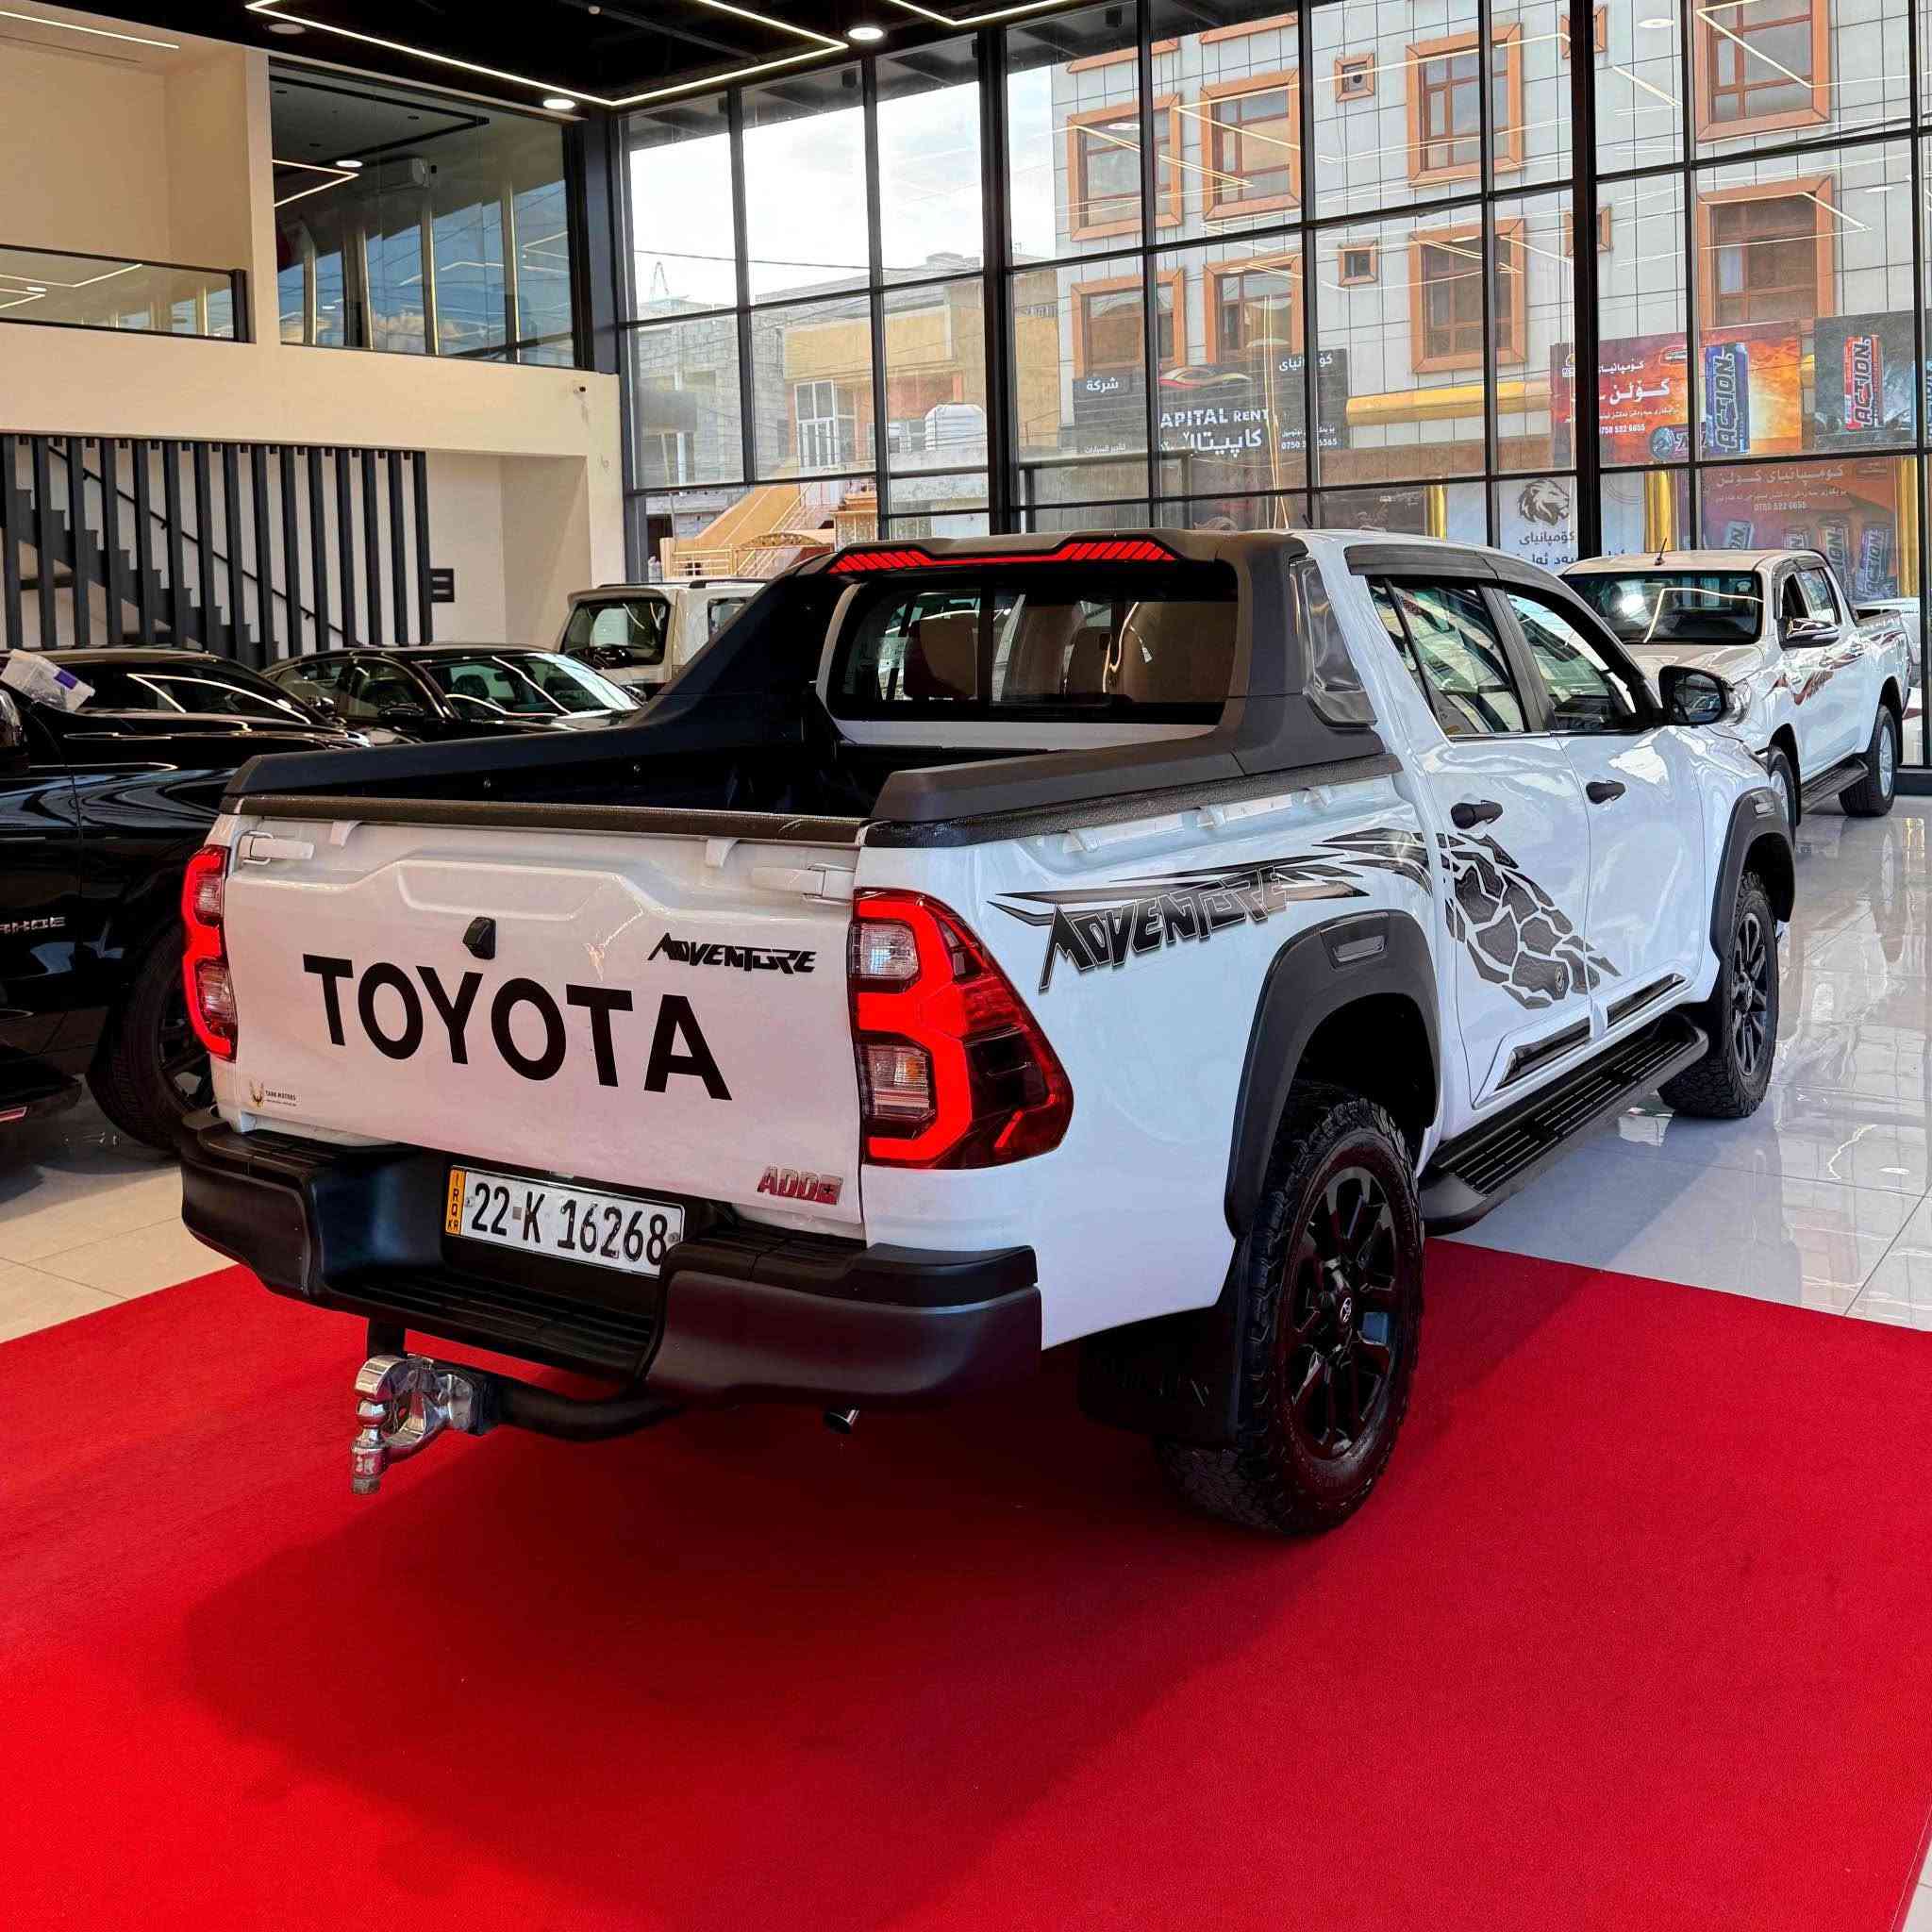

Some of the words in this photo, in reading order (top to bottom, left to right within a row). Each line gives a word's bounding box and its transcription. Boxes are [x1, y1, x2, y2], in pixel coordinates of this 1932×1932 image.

[1160, 408, 1228, 427] APITAL
[647, 932, 816, 974] ADVENTURE
[1039, 865, 1289, 991] ADVENTURE
[302, 953, 732, 1102] TOYOTA
[558, 1199, 668, 1266] 16268
